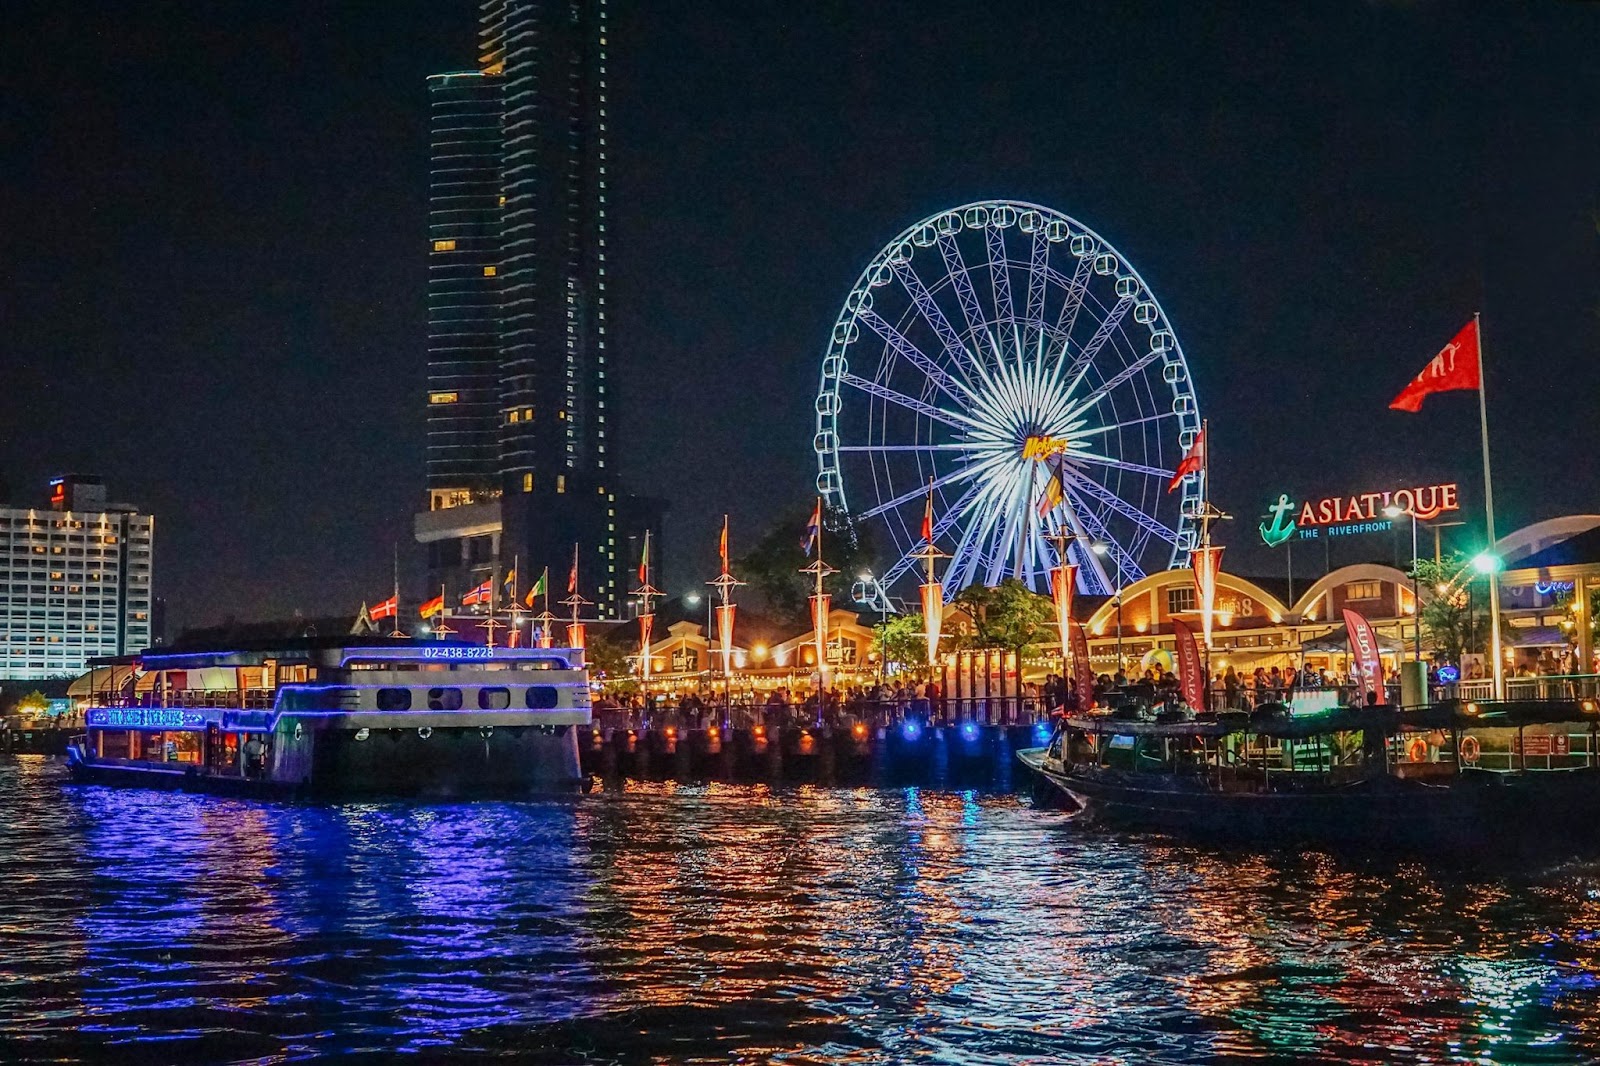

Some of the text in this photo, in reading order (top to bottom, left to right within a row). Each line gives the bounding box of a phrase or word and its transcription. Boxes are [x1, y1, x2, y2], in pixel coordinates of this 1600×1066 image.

[1297, 483, 1460, 526] ASIATIQUE
[1299, 521, 1393, 539] THE RIVERFRONT
[1241, 598, 1253, 617] 8
[424, 647, 494, 658] 02-438-8228
